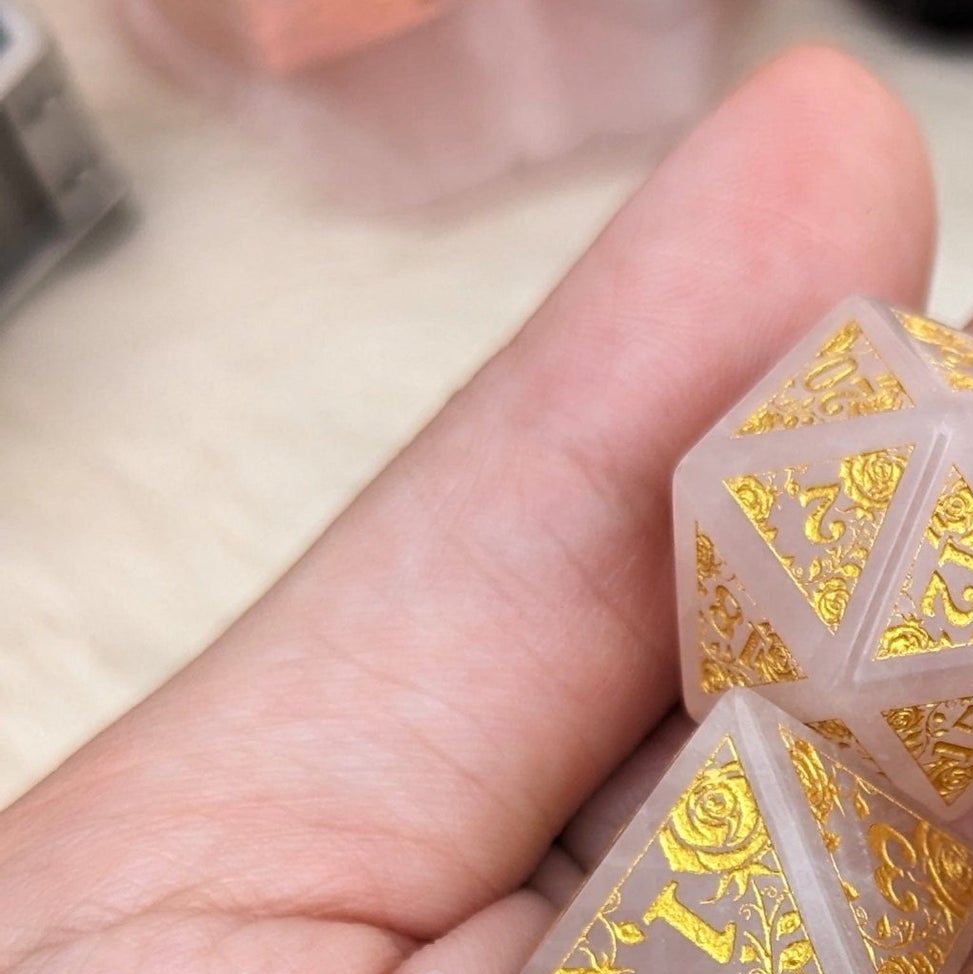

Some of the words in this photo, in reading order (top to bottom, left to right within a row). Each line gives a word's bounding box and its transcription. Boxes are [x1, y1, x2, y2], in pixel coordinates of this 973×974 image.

[800, 483, 846, 545] 2
[708, 585, 772, 665] 18
[869, 822, 918, 912] 3
[643, 880, 736, 964] 1
